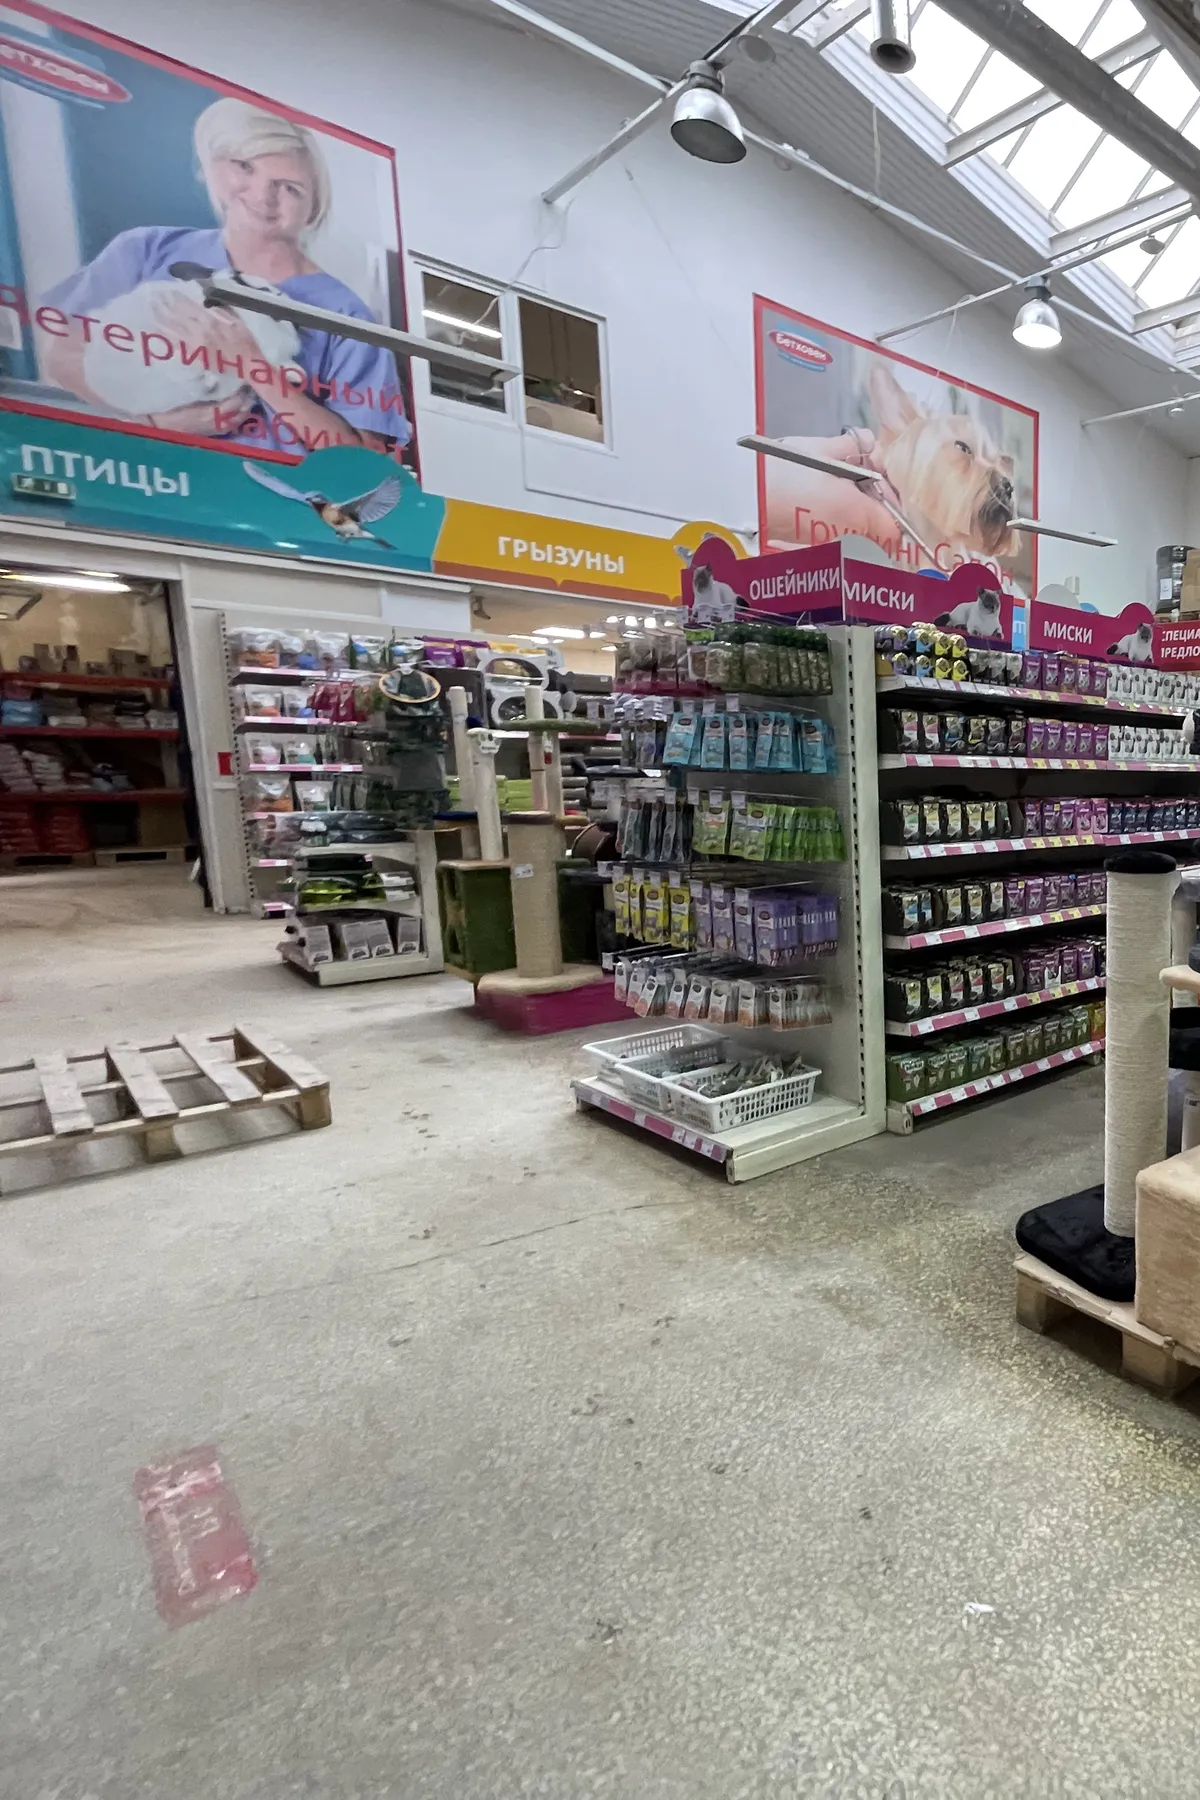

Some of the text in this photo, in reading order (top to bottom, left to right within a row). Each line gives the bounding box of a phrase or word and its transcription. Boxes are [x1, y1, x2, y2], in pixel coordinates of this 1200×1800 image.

[213, 407, 408, 464] кабит
[21, 444, 189, 496] ПТИЦЫ
[497, 536, 625, 574] ГРЫЗУНЫ
[750, 567, 840, 600] ОШЕЙНИКИ
[843, 580, 914, 612] МИСКИ
[1043, 620, 1093, 644] МИСКИ
